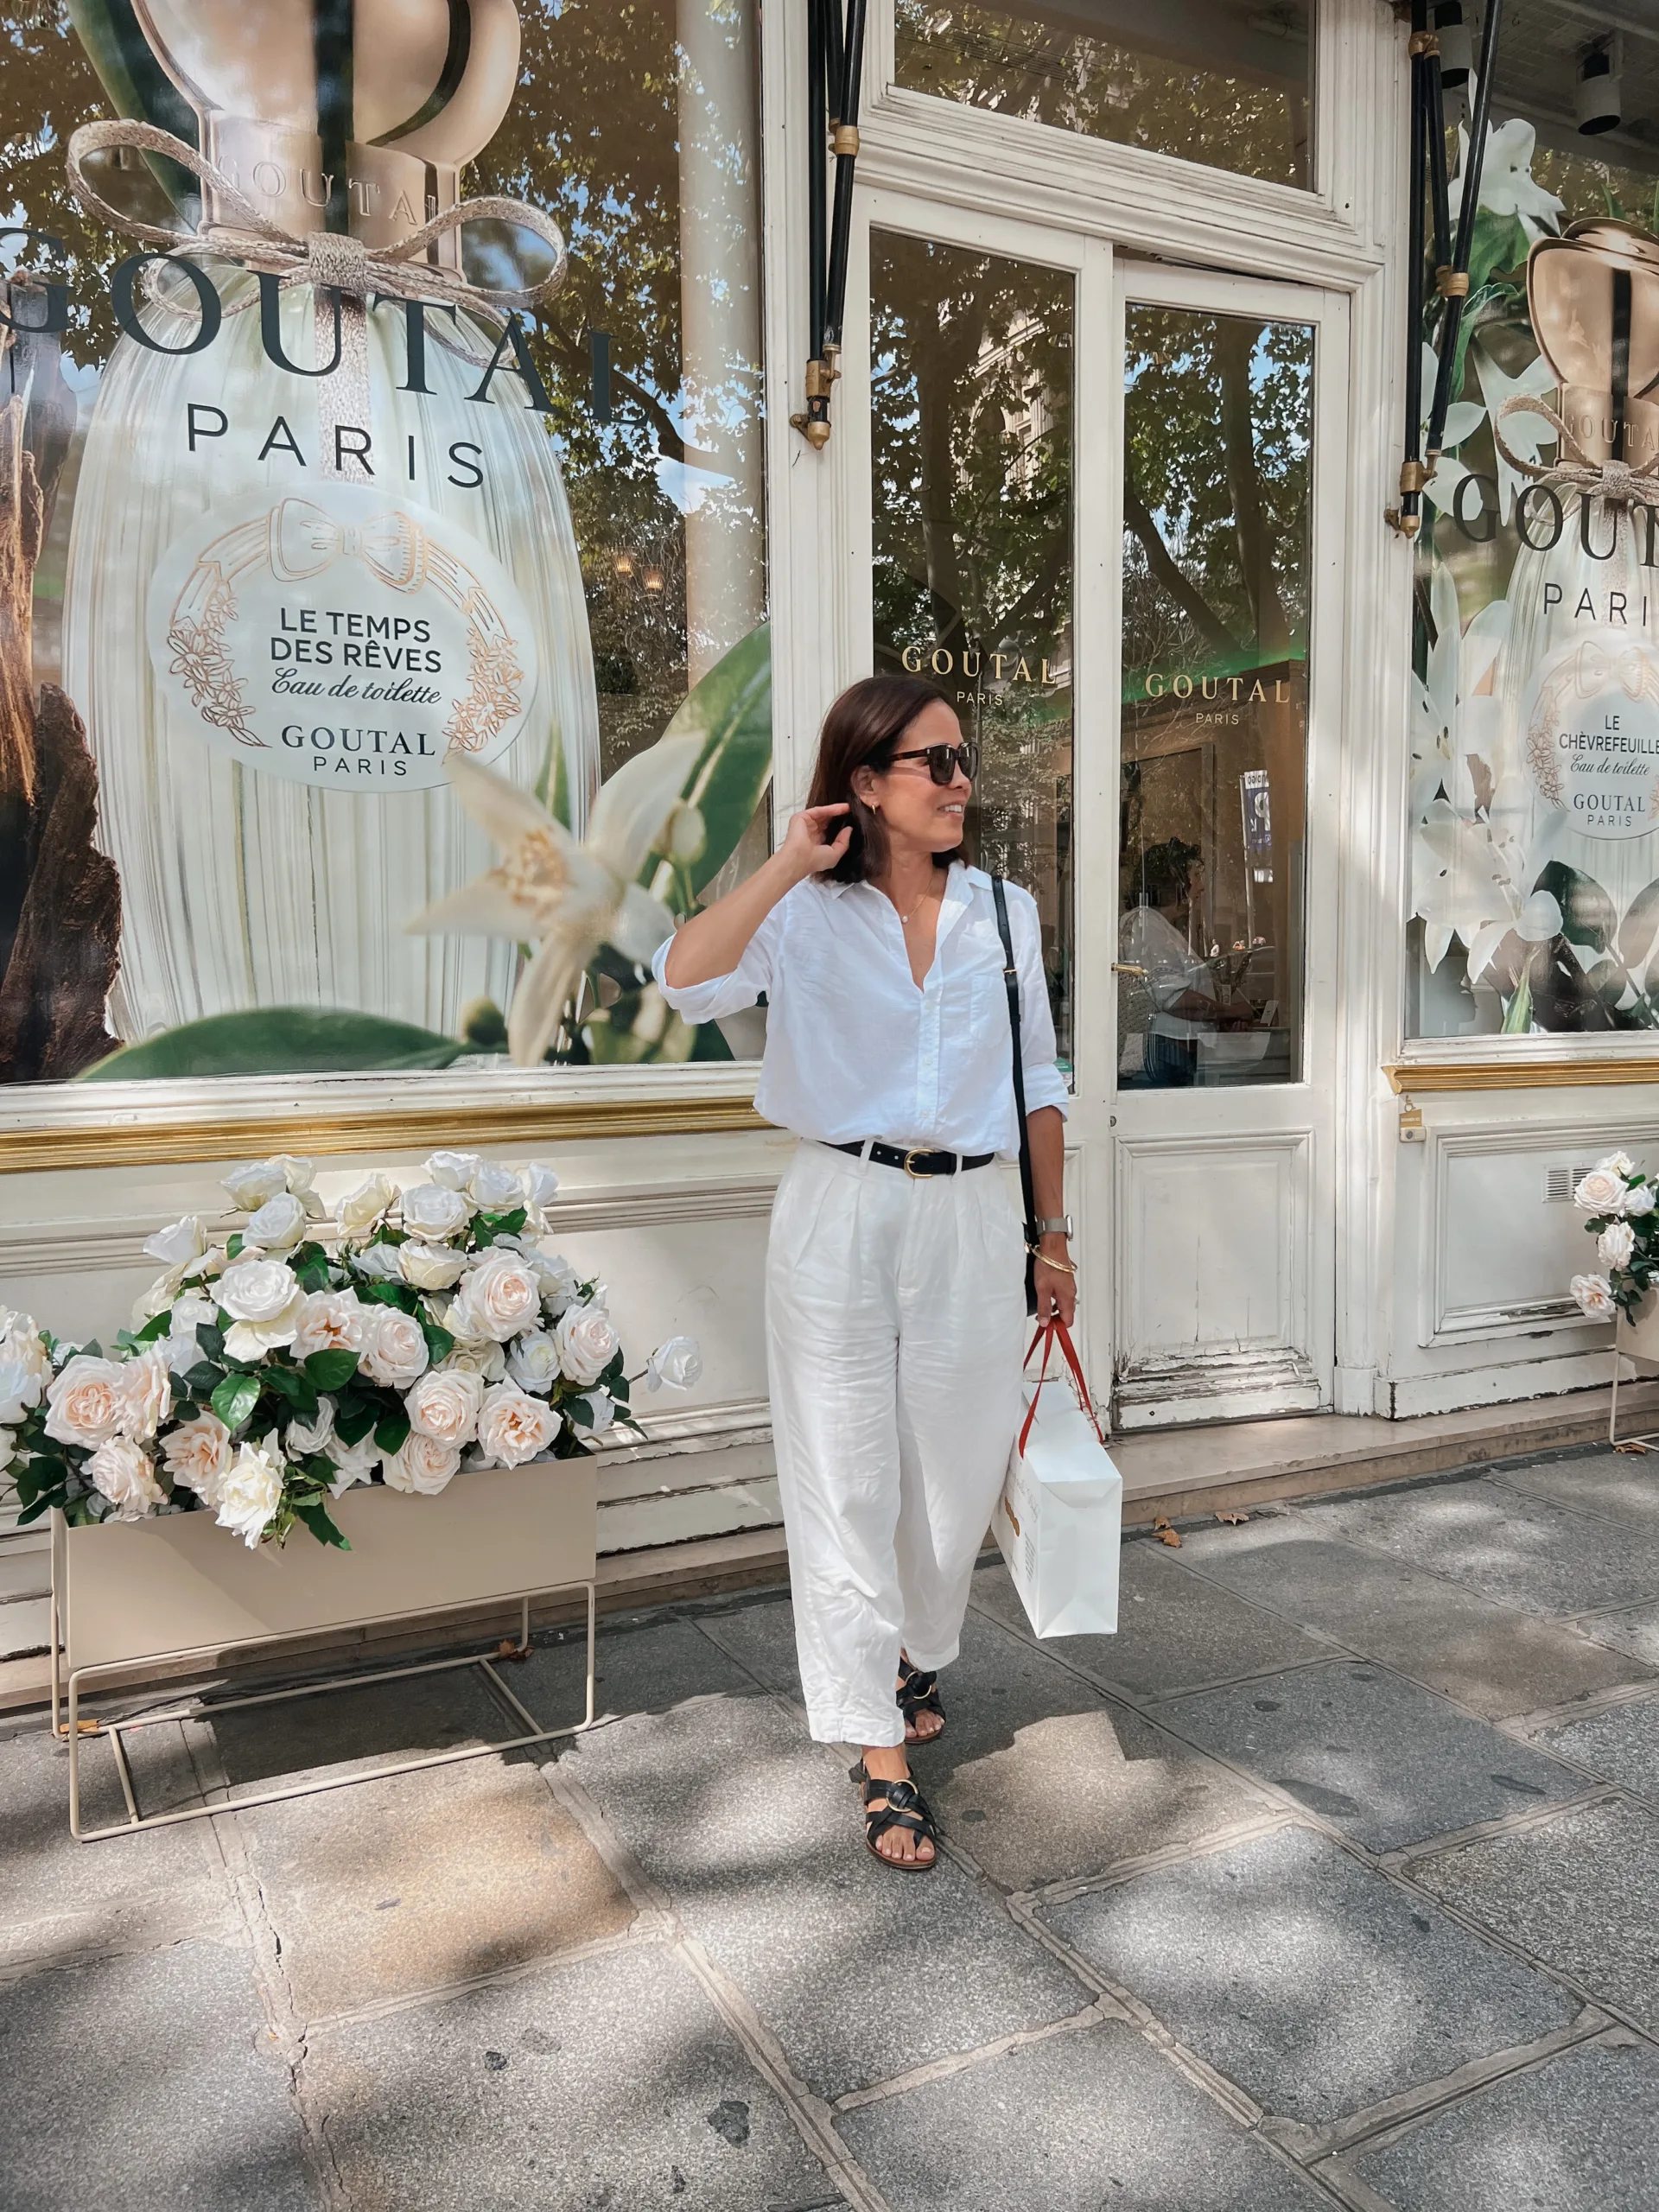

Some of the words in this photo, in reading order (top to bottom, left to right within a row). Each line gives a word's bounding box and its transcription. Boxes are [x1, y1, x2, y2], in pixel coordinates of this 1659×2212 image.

[0, 227, 652, 427] GOUTAL
[188, 403, 484, 488] PARIS
[1544, 582, 1647, 626] PARI
[280, 607, 316, 634] LE
[326, 611, 430, 643] TEMPS
[271, 637, 333, 667] DES
[344, 641, 442, 674] RÊVES
[901, 645, 1056, 684] GOUTAL
[271, 667, 326, 696] Eau
[327, 674, 358, 698] de
[362, 677, 442, 704] toilette
[956, 690, 1004, 707] PARIS
[1145, 673, 1291, 704] GOUTAL
[1195, 712, 1240, 726] PARIS
[1605, 715, 1620, 730] LE
[282, 725, 436, 756] GOUTAL
[314, 756, 407, 776] PARIS
[1570, 753, 1595, 773] Eau
[1597, 757, 1611, 774] de
[1612, 757, 1650, 776] toilette
[1573, 793, 1646, 812] GOUTAL
[1587, 815, 1631, 827] PARIS
